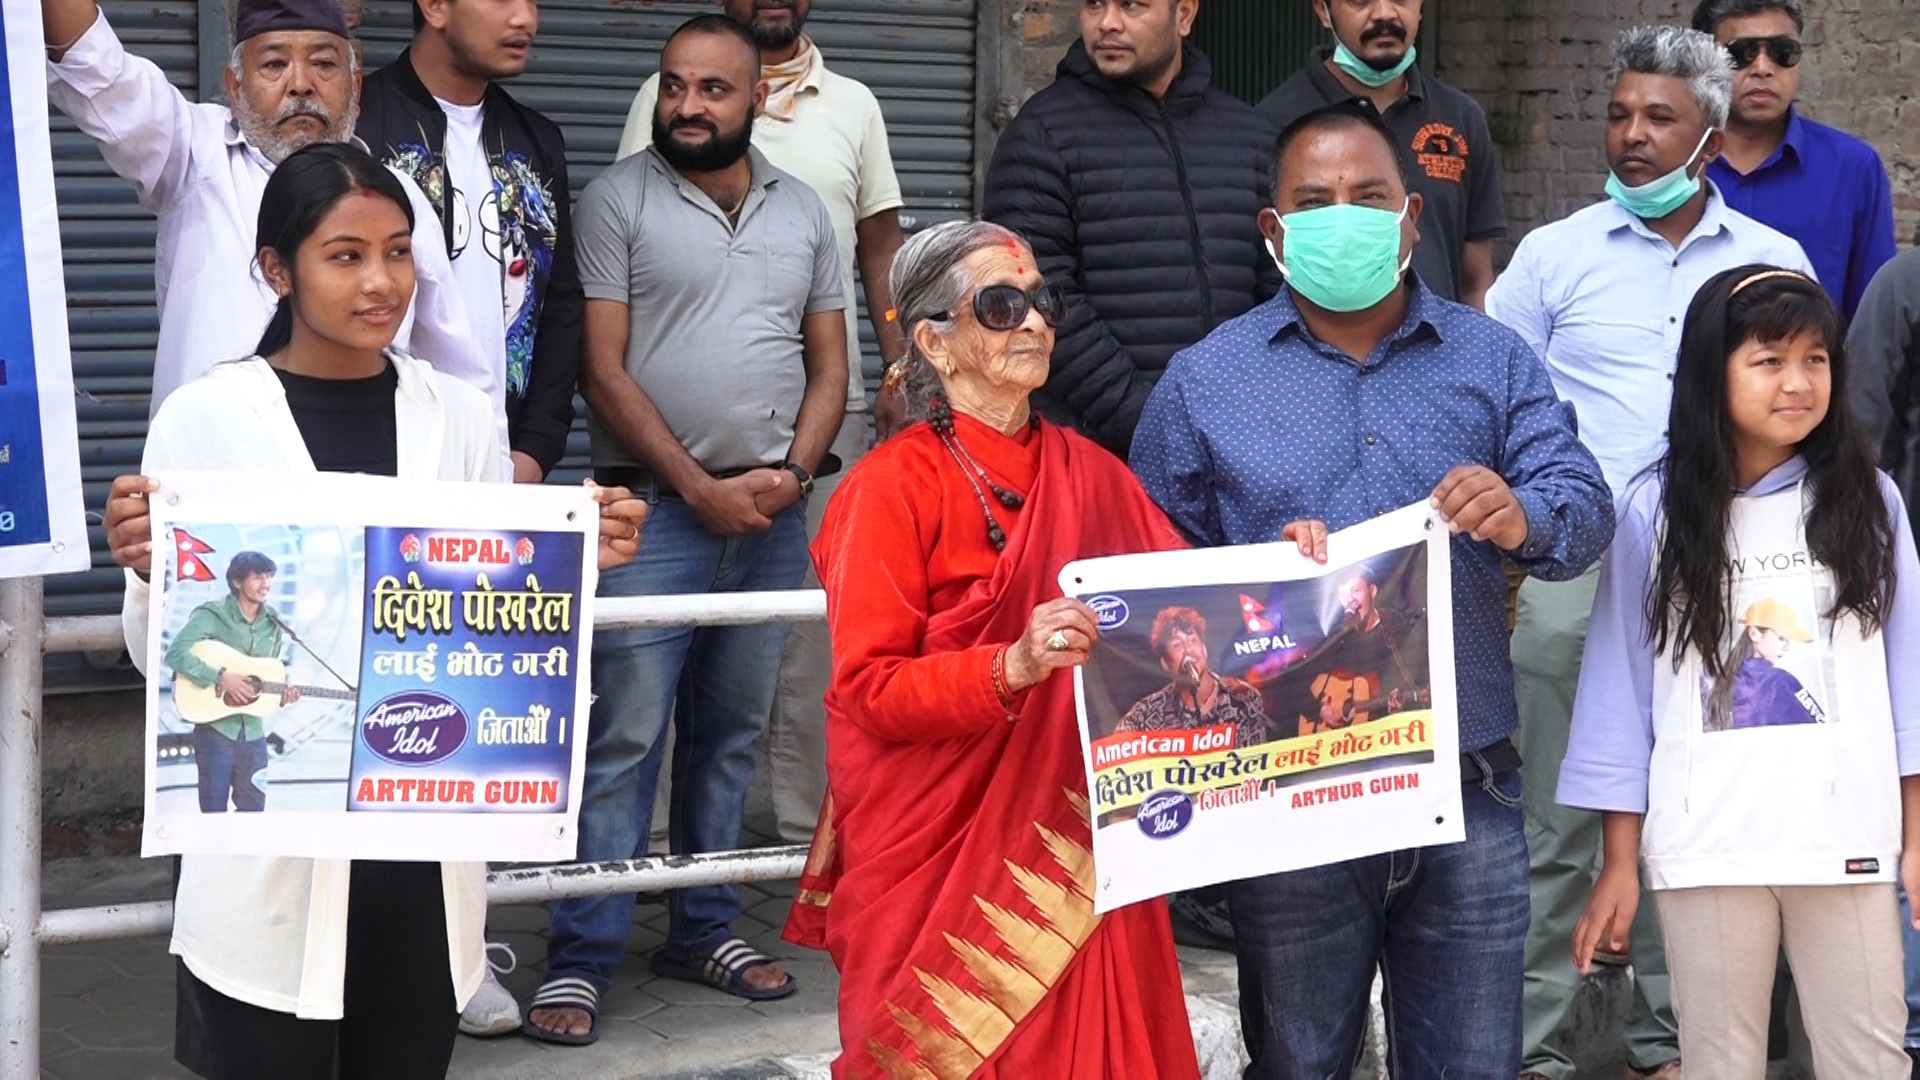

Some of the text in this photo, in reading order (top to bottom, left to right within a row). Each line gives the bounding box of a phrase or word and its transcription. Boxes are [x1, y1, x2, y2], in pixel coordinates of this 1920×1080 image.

[427, 537, 510, 564] NEPAL
[1754, 551, 1826, 571] YORK
[373, 571, 573, 638] दिवेश पोखरेल
[1234, 635, 1297, 655] NEPAL
[373, 642, 570, 683] लाई भोट गरी
[363, 702, 457, 730] American
[387, 725, 440, 755] Idol
[1096, 727, 1233, 766] American Idol
[1096, 768, 1154, 805] दिवेश
[1164, 752, 1271, 786] पोखरेल
[1275, 740, 1323, 768] लाई
[1379, 719, 1426, 746] गरी
[356, 777, 559, 804] ARTHUR GUNN
[1291, 772, 1420, 810] ARTHUR GUNN
[1153, 809, 1179, 834] Idol
